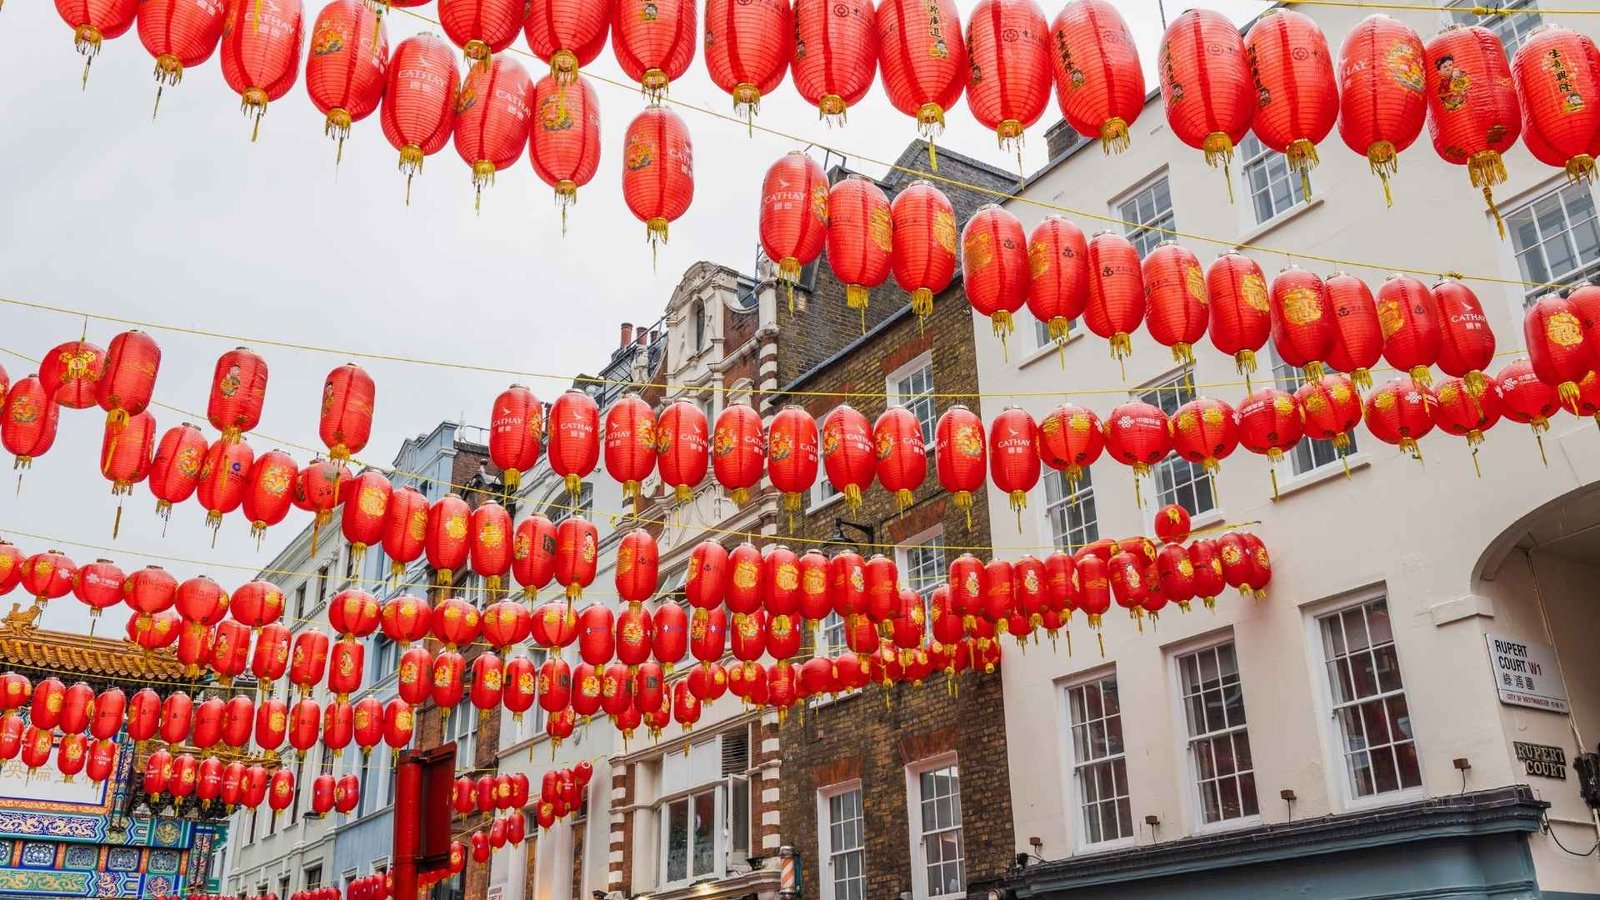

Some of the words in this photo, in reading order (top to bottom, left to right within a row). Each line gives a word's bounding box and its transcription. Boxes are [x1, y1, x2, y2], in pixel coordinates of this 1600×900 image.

[245, 12, 296, 35] CTHAY
[399, 69, 446, 87] CATHAY
[765, 191, 807, 204] CATHAY
[492, 417, 522, 428] CATHAY
[560, 422, 593, 433] CATHAY
[998, 439, 1031, 449] CATHAY
[1494, 640, 1528, 658] RUPERT
[1498, 656, 1526, 673] COURT
[1528, 662, 1542, 676] W1
[1516, 743, 1565, 762] RUPERT
[1525, 760, 1566, 778] COURT
